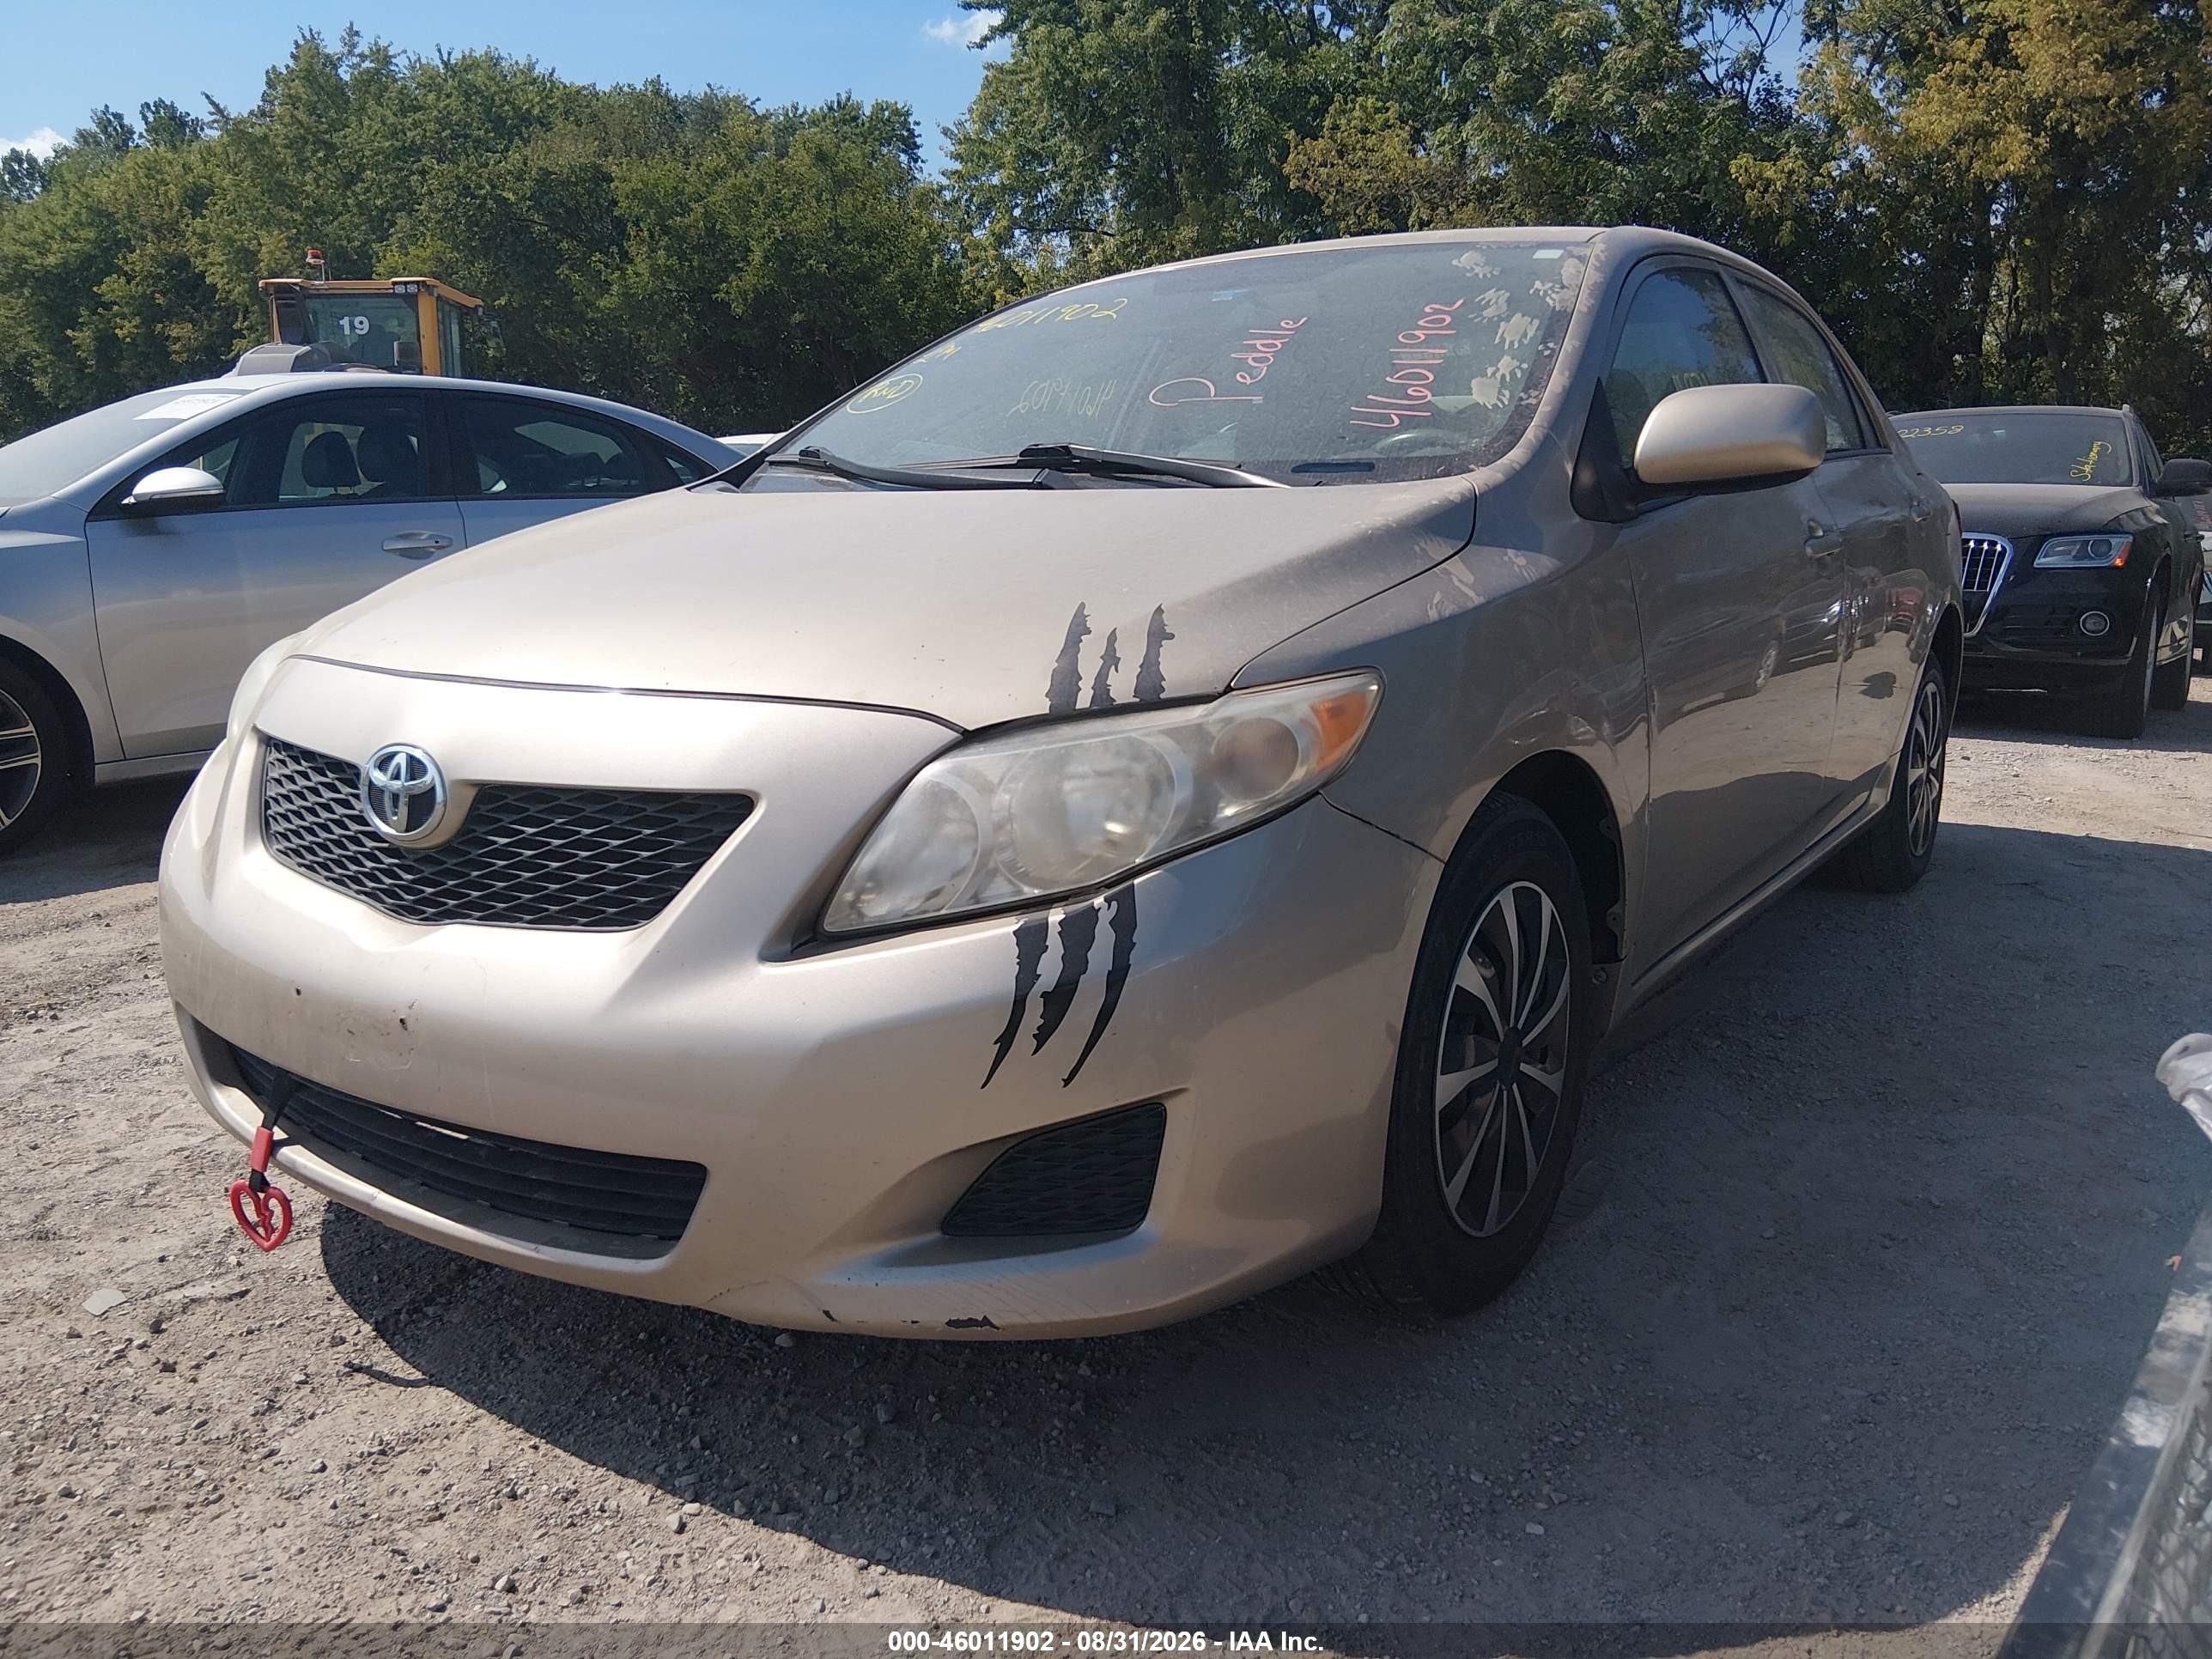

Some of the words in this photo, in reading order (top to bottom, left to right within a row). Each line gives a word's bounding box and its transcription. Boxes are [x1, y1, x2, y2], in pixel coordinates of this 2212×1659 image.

[338, 315, 369, 335] 19
[1148, 316, 1308, 407] Peddle
[1350, 298, 1464, 428] 46011902
